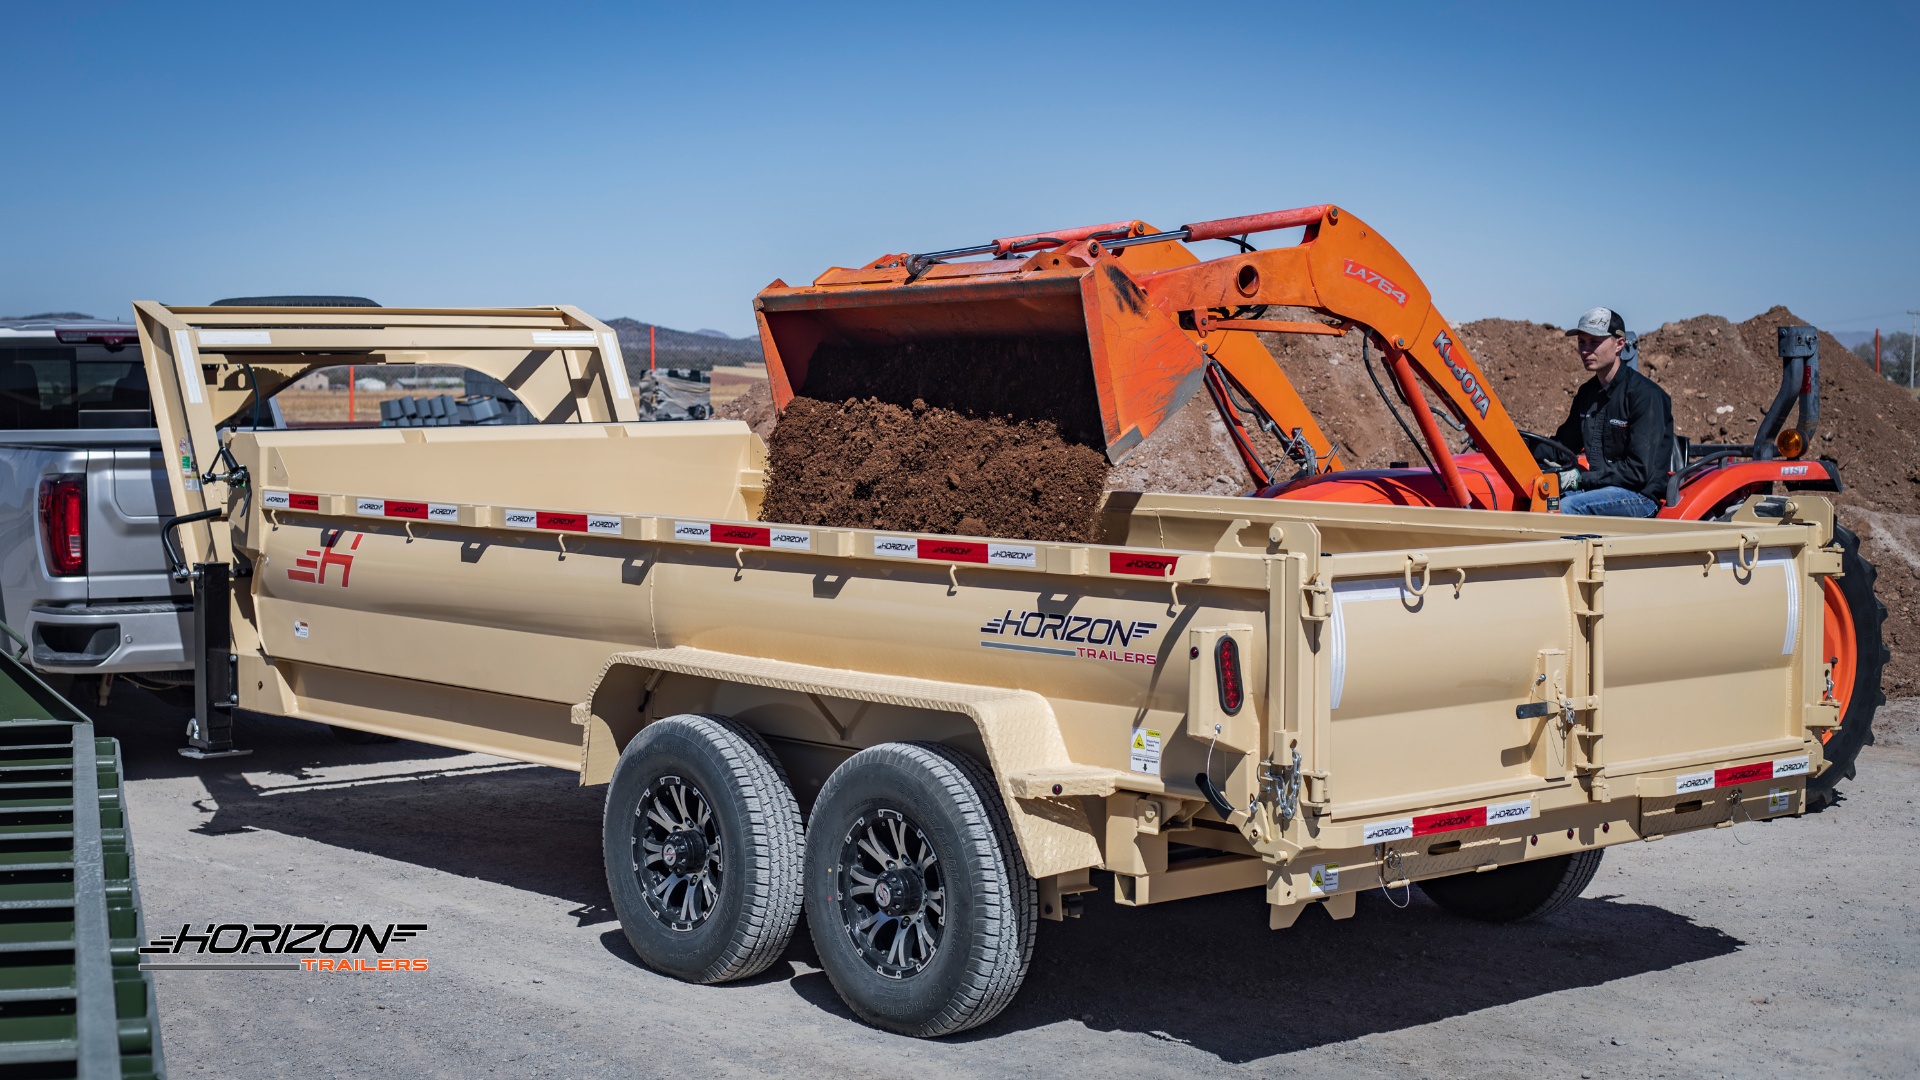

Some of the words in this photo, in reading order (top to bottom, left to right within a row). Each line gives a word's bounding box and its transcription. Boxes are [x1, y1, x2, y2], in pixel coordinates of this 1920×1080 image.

[1345, 264, 1407, 304] LA764
[1433, 330, 1491, 420] KUBOTA
[1781, 466, 1808, 476] HST
[592, 520, 618, 528] HORIZON
[679, 527, 707, 535] HORIZON
[727, 530, 755, 539] HORIZON
[776, 534, 806, 543] HORIZON
[882, 542, 912, 551] HORIZON
[937, 545, 970, 555] HORIZON
[996, 550, 1031, 559] HORIZON
[1000, 610, 1136, 647] HORIZON
[1076, 647, 1157, 664] TRAILERS
[1780, 762, 1805, 772] HORIZON
[1683, 777, 1710, 788] HORIZON
[1494, 808, 1527, 819] HORIZON
[1435, 816, 1468, 828] HORIZON
[1371, 826, 1406, 838] HORIZON
